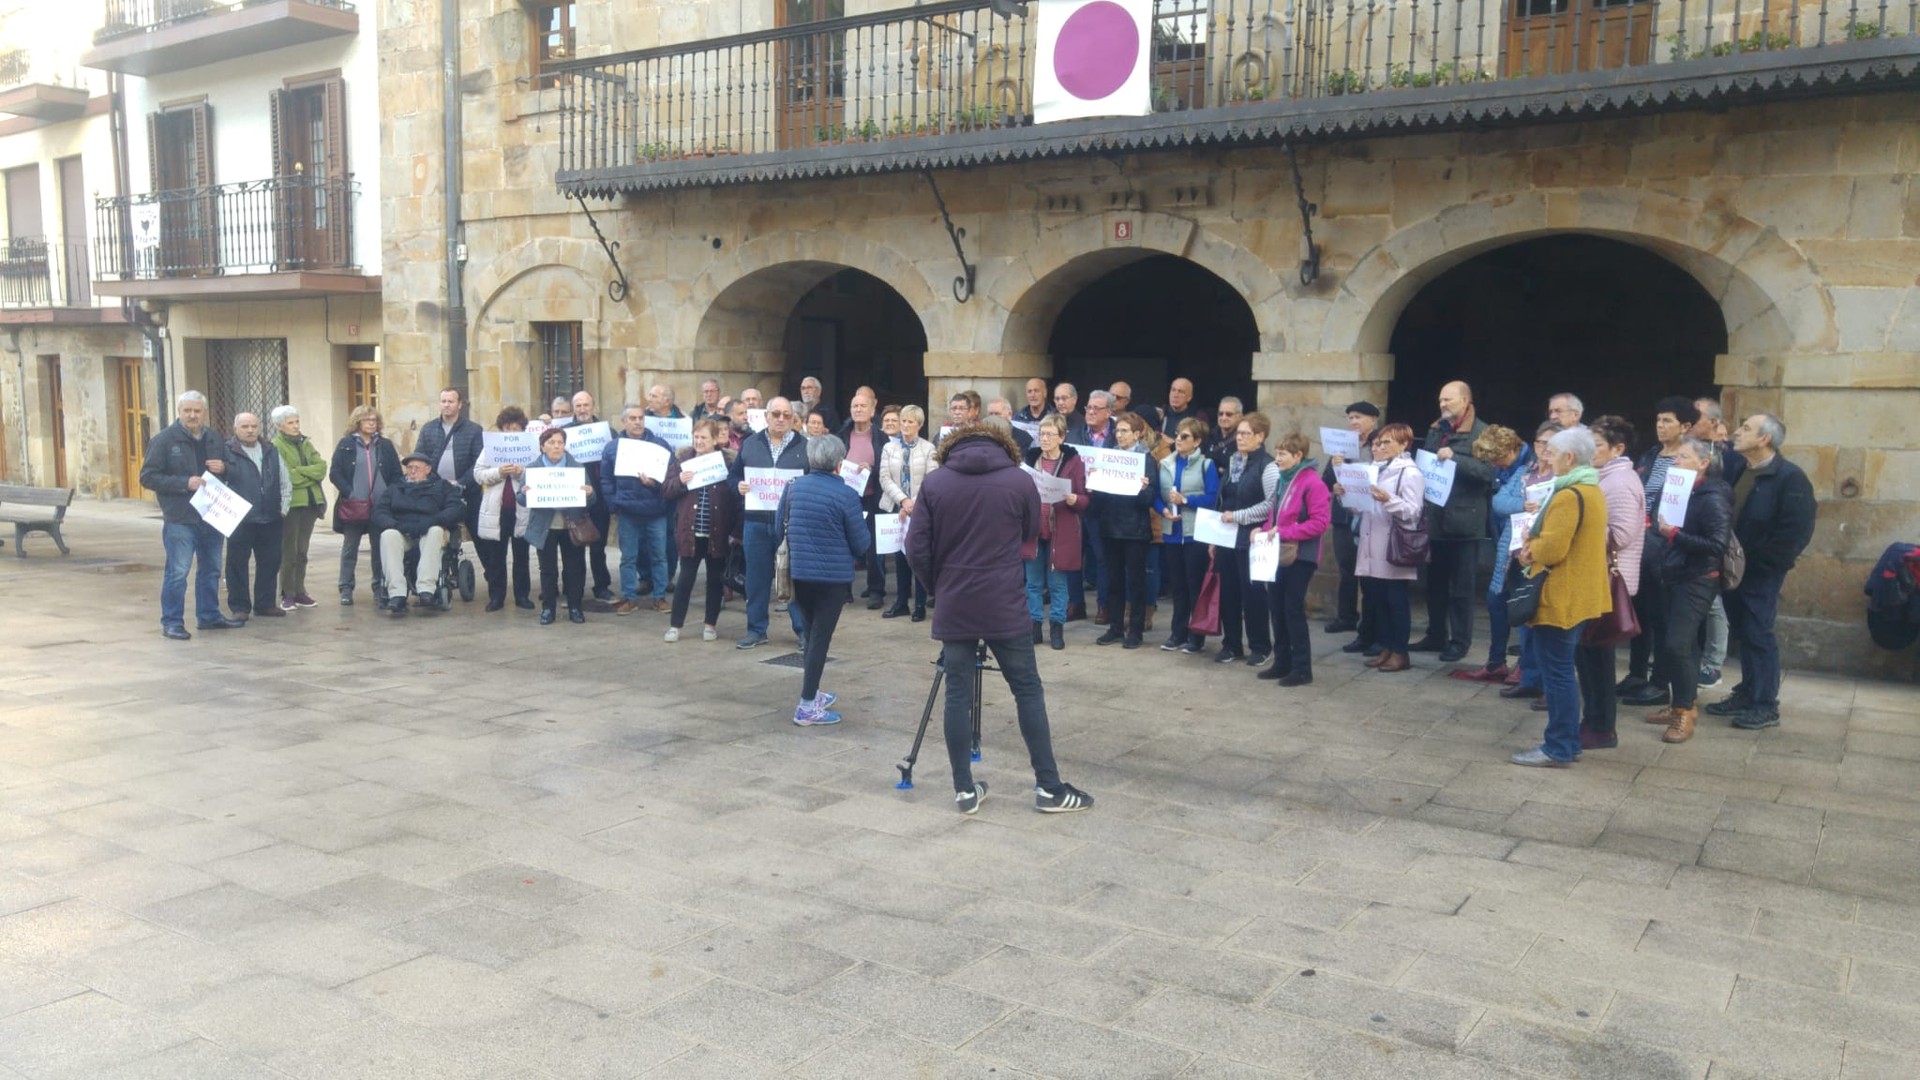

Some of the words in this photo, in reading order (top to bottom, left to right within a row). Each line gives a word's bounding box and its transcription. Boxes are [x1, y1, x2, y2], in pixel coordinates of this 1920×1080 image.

[503, 435, 520, 443] POR
[569, 437, 605, 450] NUESTROS
[493, 445, 532, 453] NUESTROS
[1102, 453, 1139, 466] PENTSIO
